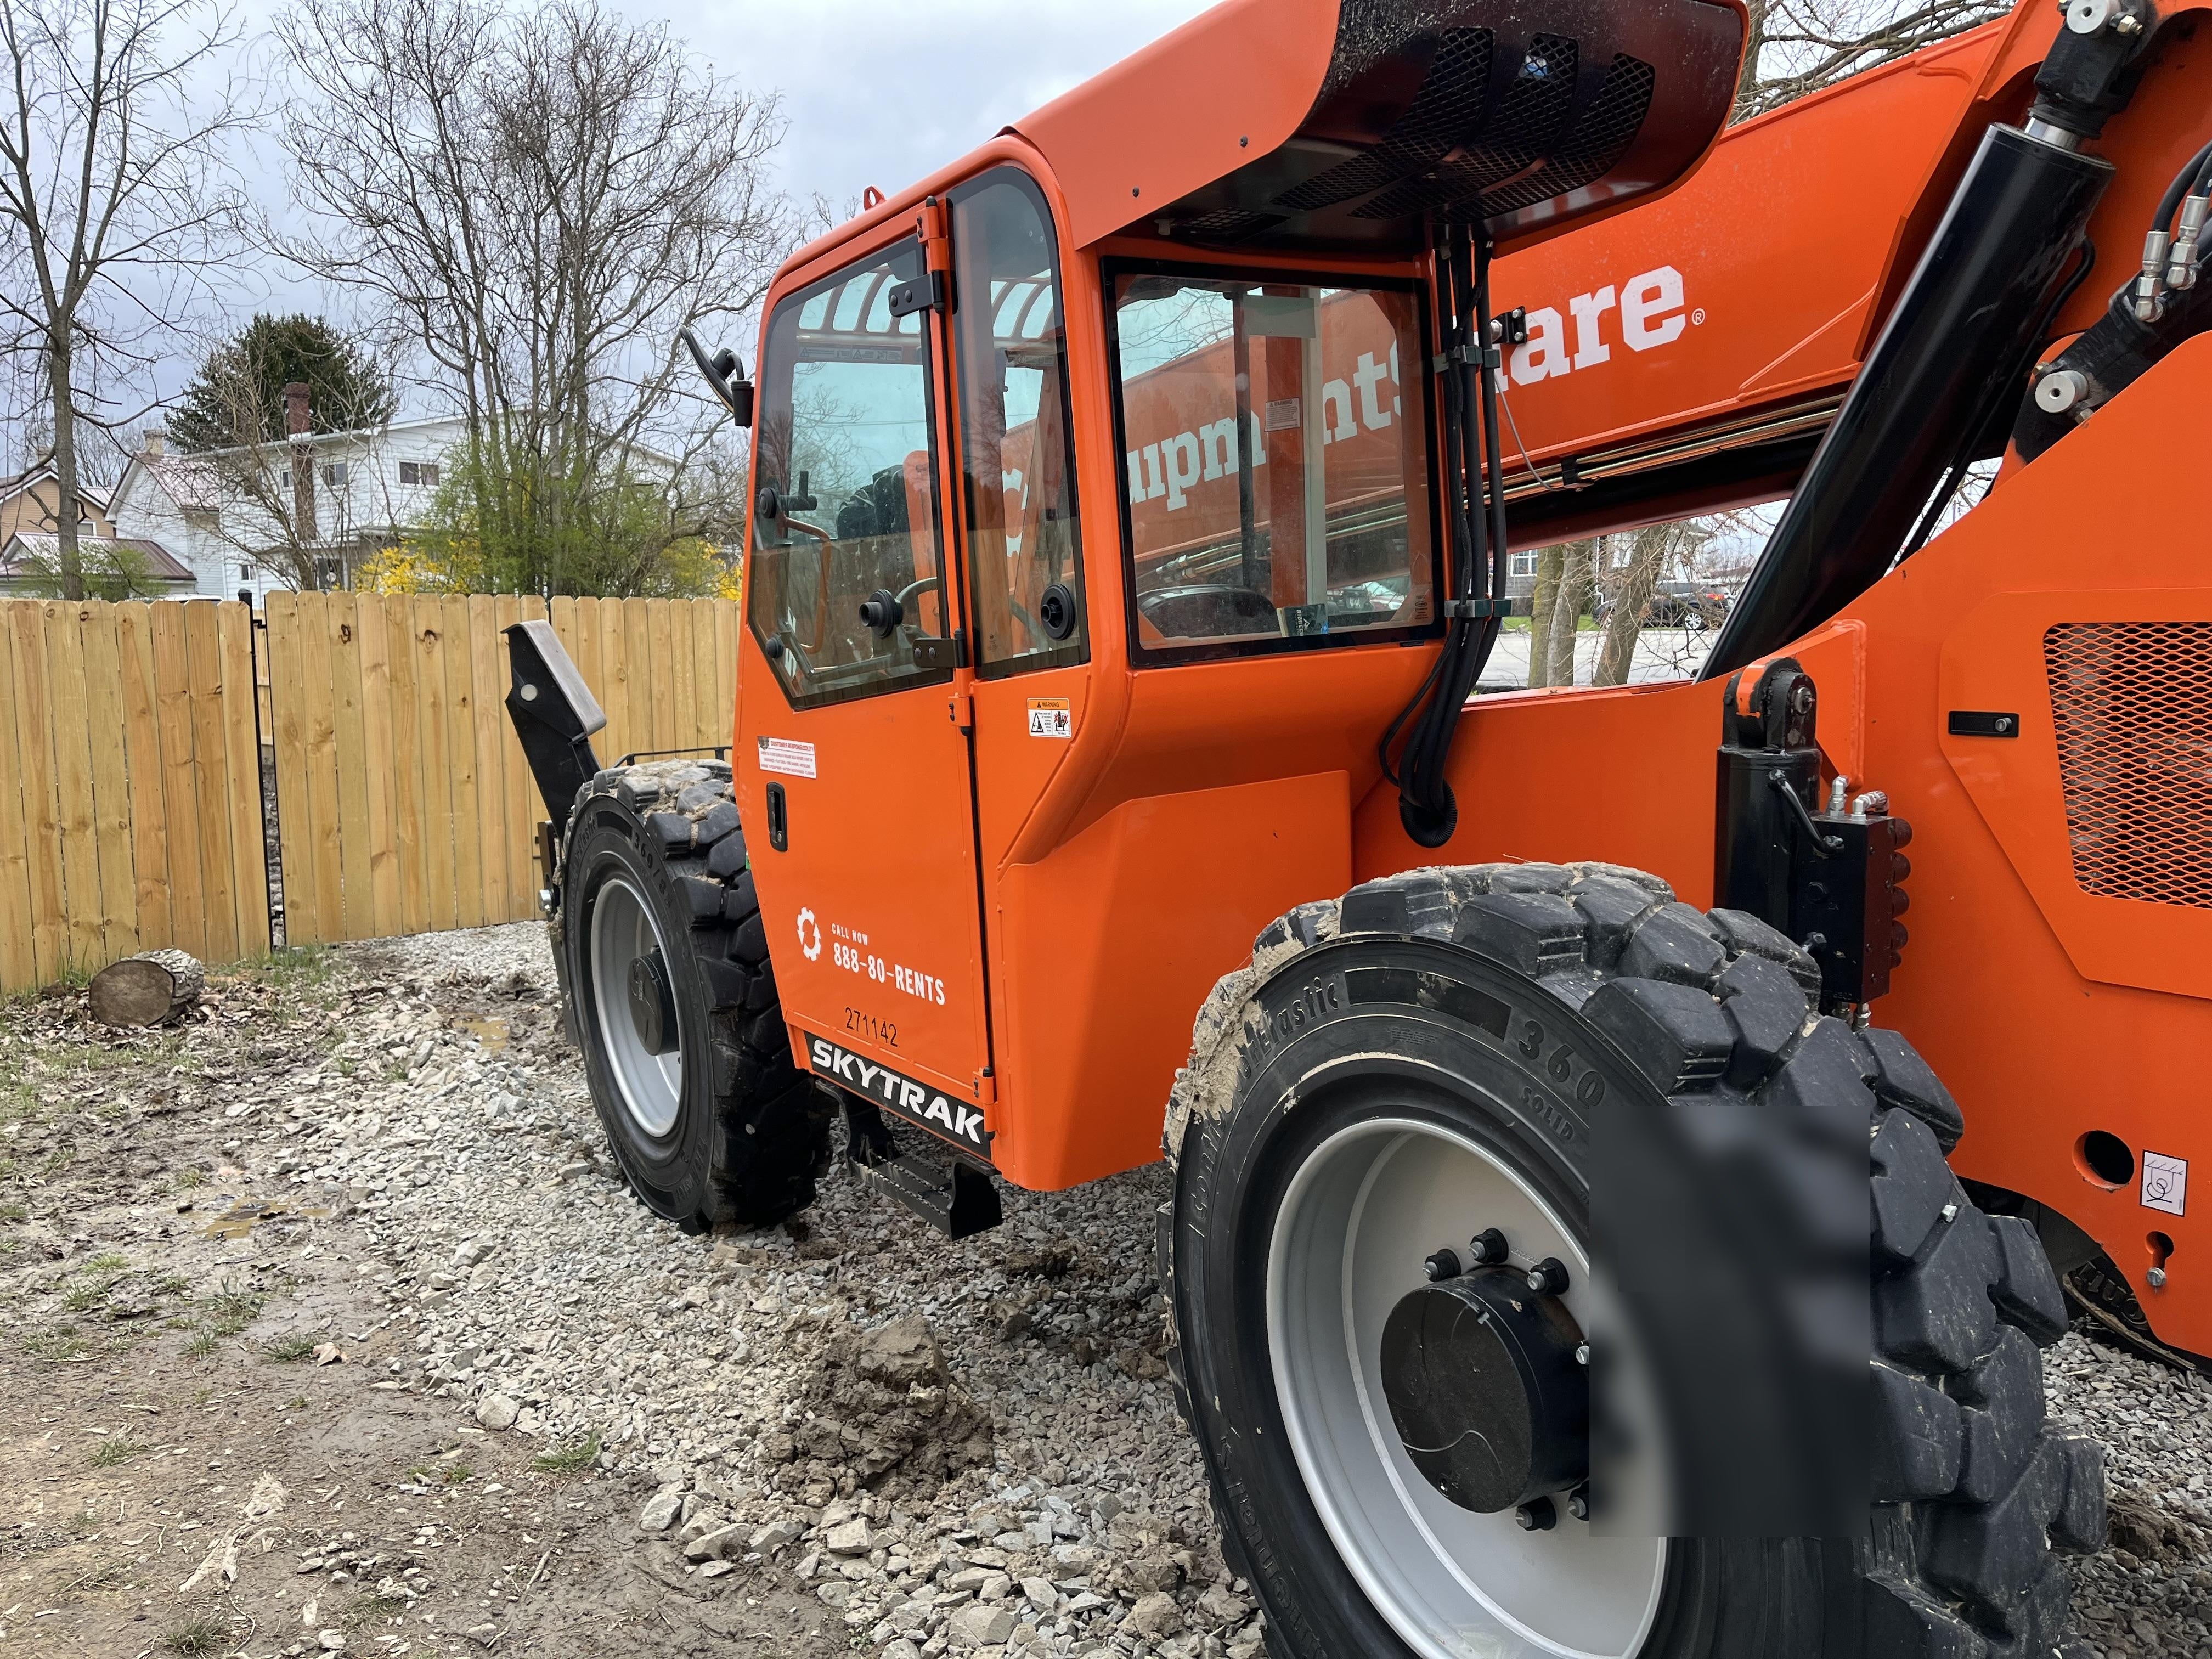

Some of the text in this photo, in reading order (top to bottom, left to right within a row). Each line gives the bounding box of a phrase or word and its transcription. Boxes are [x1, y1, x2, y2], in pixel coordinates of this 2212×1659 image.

[832, 923, 868, 946] CALL NOW
[833, 942, 946, 1006] 888-80-RENTS
[845, 1007, 899, 1047] 271142
[812, 1039, 984, 1144] SKYTRAK
[1520, 1086, 1576, 1141] SOLID
